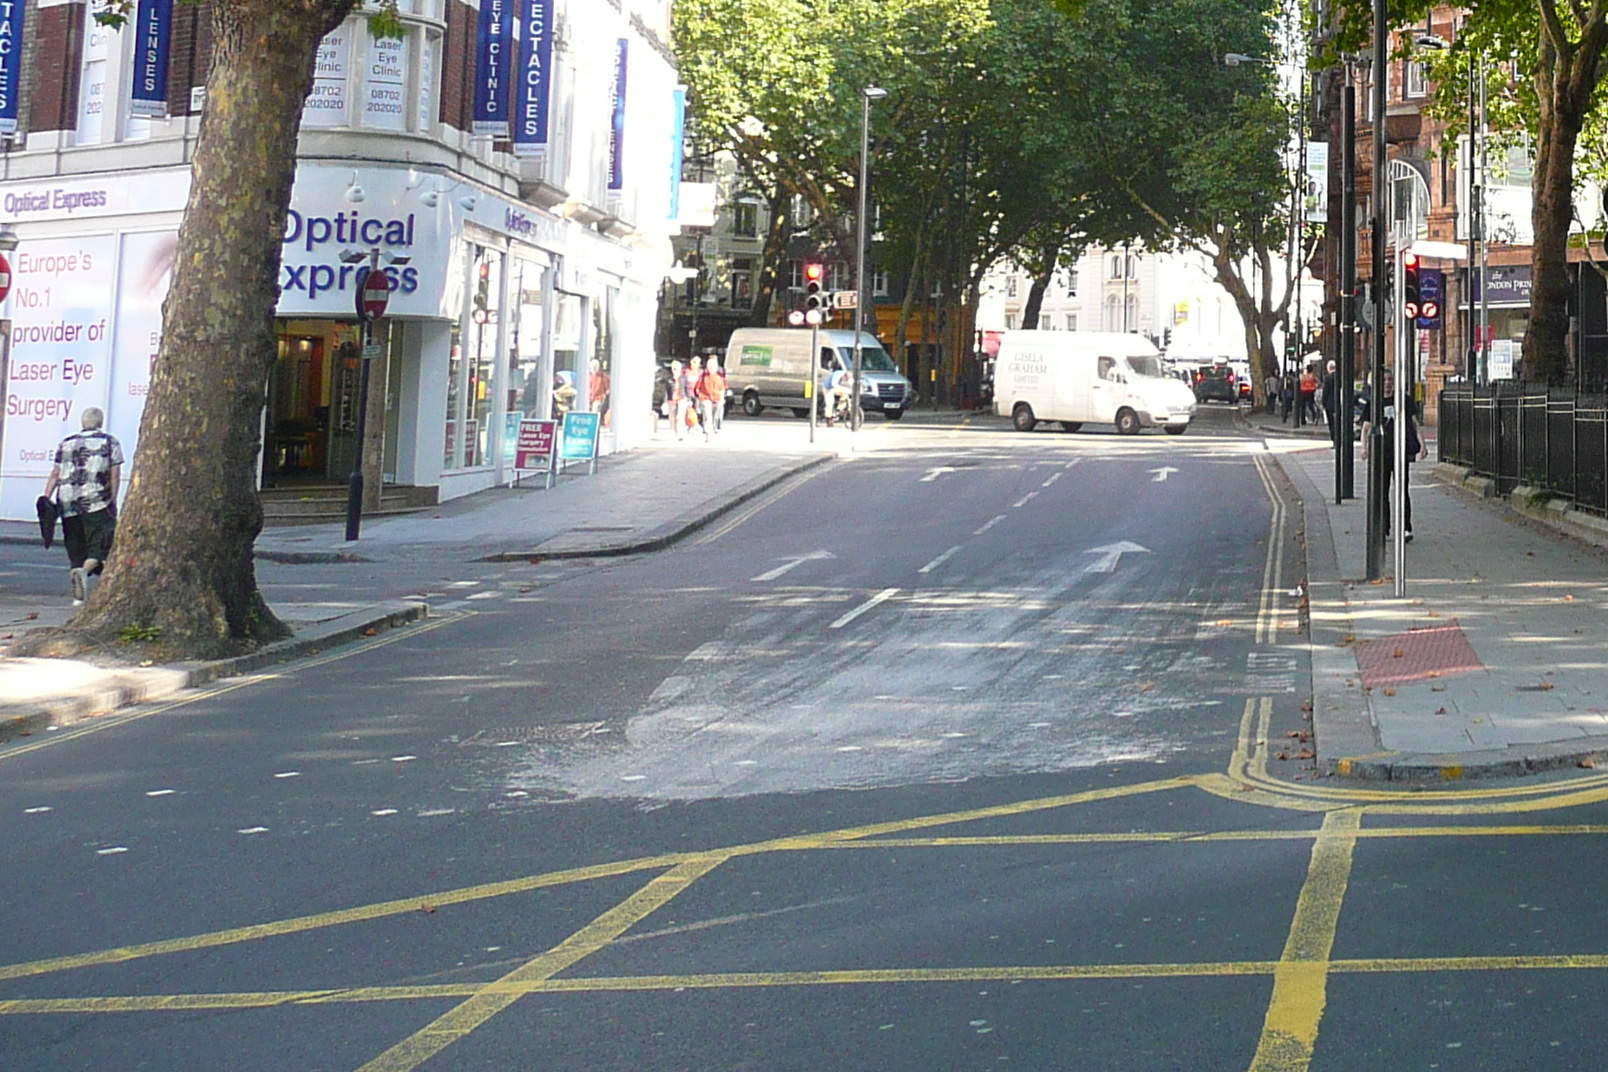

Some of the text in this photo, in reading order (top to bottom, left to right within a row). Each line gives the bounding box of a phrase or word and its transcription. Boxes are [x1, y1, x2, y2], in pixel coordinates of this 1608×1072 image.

[491, 0, 502, 35] EYE
[144, 7, 159, 92] LENSES
[373, 39, 402, 50] Laser
[378, 52, 398, 64] Eye
[317, 61, 342, 72] linic
[372, 64, 402, 76] Clinic
[485, 43, 500, 113] CLINIC
[314, 86, 342, 96] 8702
[4, 188, 107, 217] Optical Express
[283, 209, 415, 252] Optical
[18, 250, 92, 278] Europe's
[15, 287, 51, 309] No.1
[1487, 280, 1513, 290] ONDON
[12, 319, 107, 348] provider of
[10, 359, 94, 386] Laser Eye
[7, 394, 73, 422] Surgery
